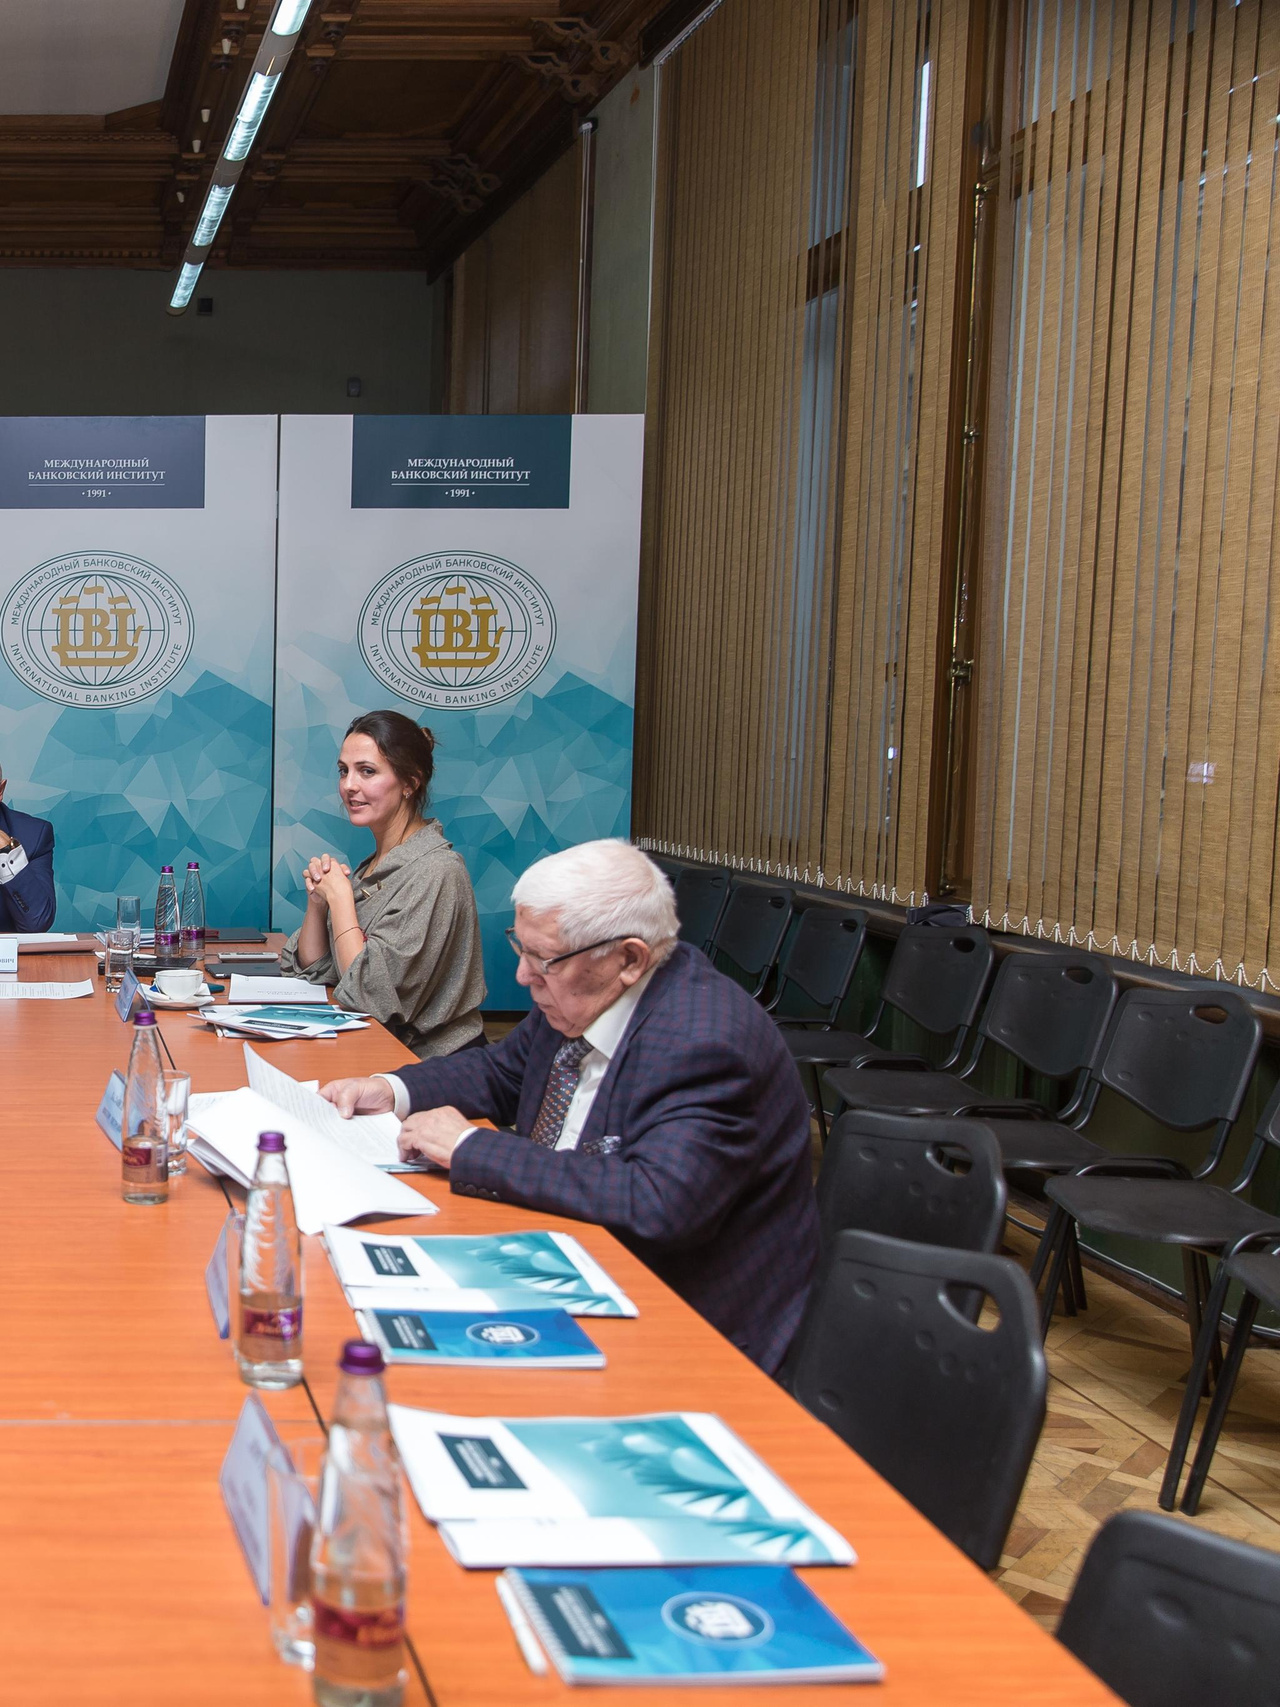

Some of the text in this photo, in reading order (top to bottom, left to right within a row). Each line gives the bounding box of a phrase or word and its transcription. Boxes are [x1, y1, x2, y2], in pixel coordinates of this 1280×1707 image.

[28, 469, 166, 482] БАНКОВСКИЙ ИНСТИТУТ
[44, 457, 149, 469] МЕЖДУНАРОДНЫЙ
[391, 468, 531, 481] БАНКОВСКИЙ ИНСТИТУТ
[407, 457, 514, 469] МЕЖДУНАРОДНЫЙ
[11, 557, 182, 627] МЕЖДУНАРОДНЫЙ БАНКОВСКИЙ ИНСТИТУТ
[370, 557, 545, 627] МЕЖДУНАРОДНЫЙ БАНКОВСКИЙ ИНСТИТУТ
[10, 642, 182, 703] INTERNATIONAL BANKING INSTITUTE
[370, 643, 544, 704] INTERNATIONAL BANKING INSTITUTE
